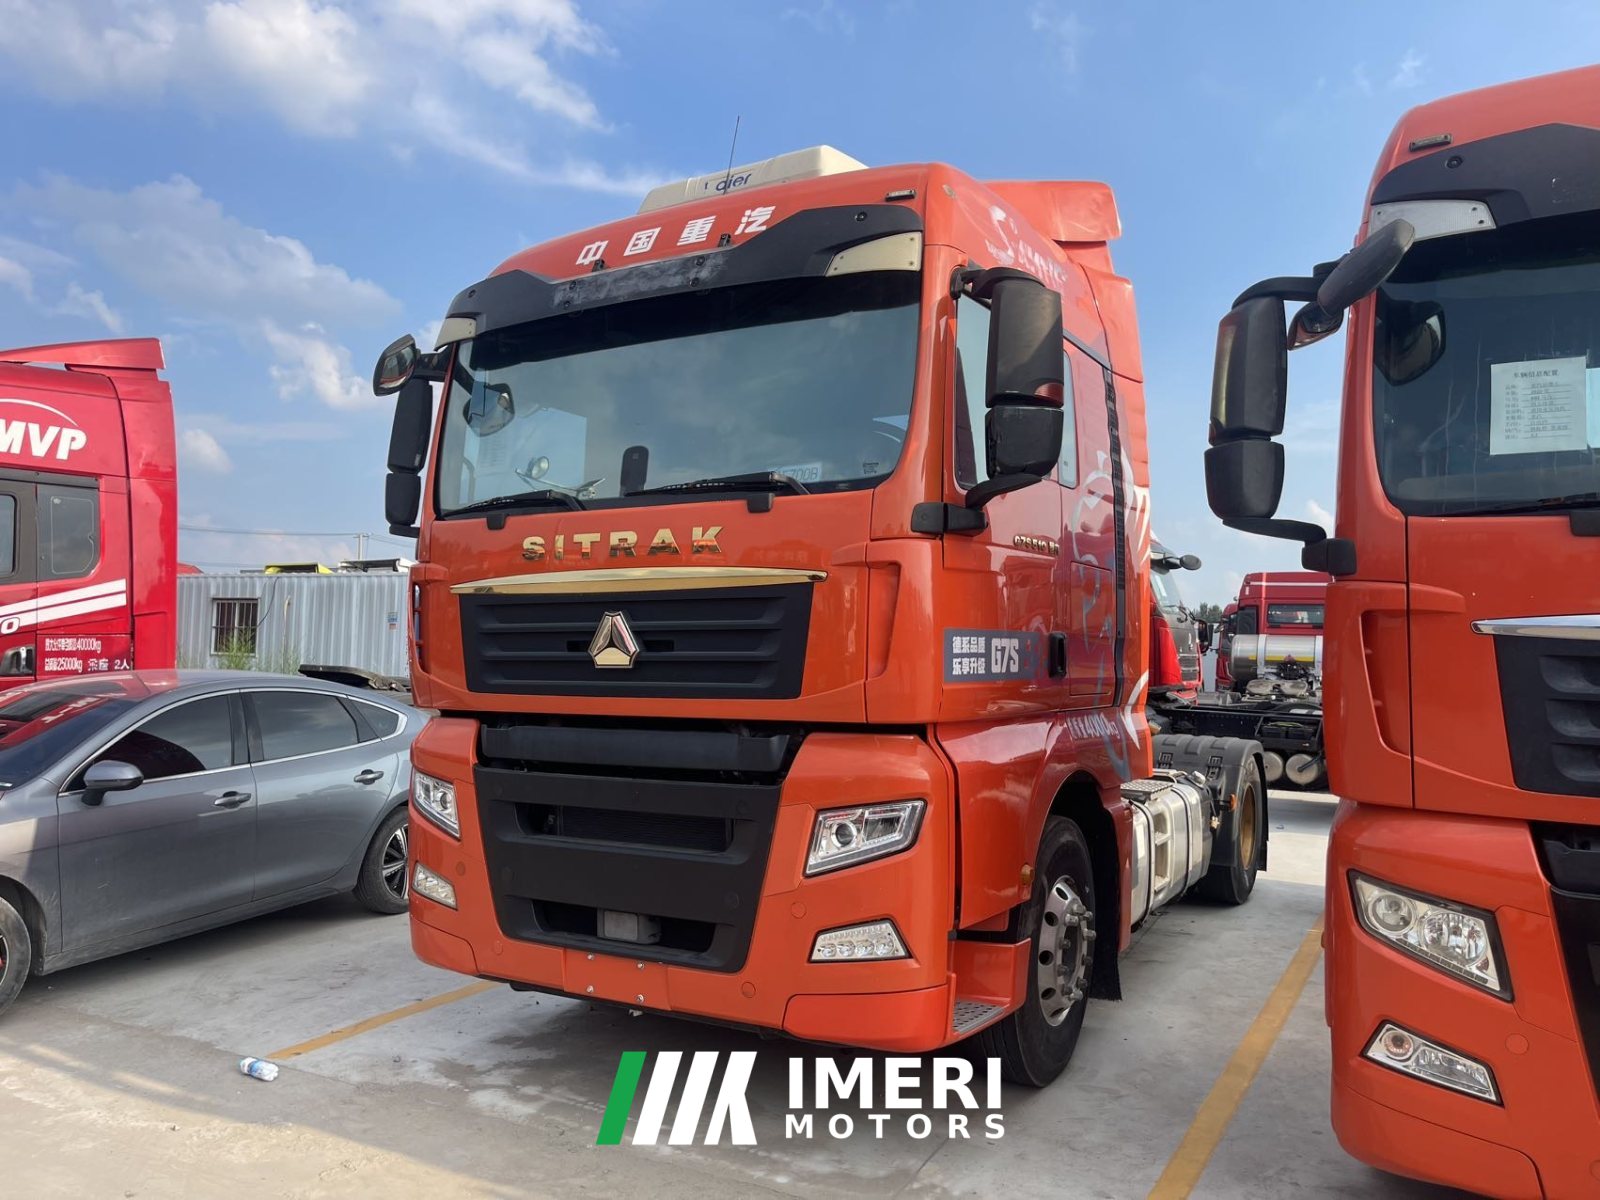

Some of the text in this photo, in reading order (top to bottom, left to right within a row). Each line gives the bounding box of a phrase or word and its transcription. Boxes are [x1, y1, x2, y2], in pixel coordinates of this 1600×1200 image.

[704, 173, 752, 192] aier
[575, 205, 776, 266] 中国重汽
[0, 418, 87, 460] MVP
[522, 526, 724, 561] SITRAK
[952, 657, 986, 675] 乐享升级
[991, 638, 1019, 673] G7S
